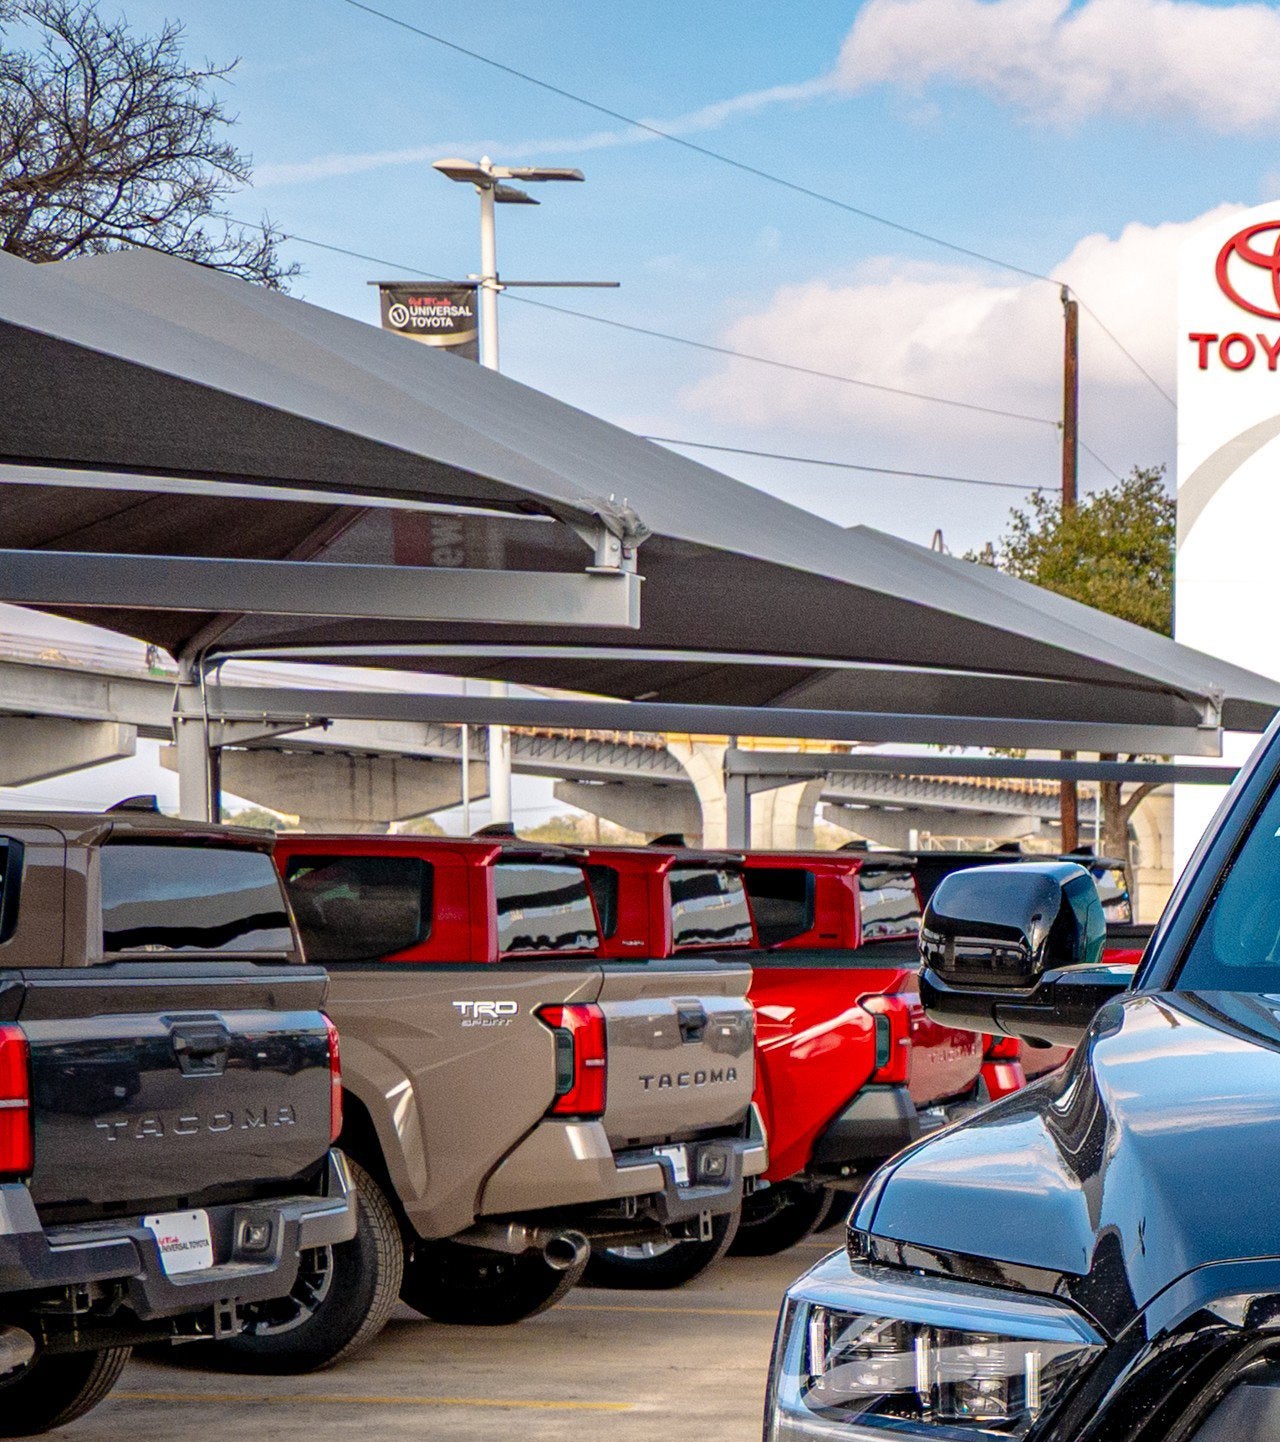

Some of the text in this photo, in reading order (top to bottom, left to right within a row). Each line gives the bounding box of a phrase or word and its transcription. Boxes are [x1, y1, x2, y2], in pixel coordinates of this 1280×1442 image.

[410, 305, 474, 317] UNIVERSAL
[411, 316, 454, 328] TOYOTA
[452, 1000, 519, 1018] TRD
[639, 1067, 738, 1092] TACOMA
[95, 1104, 295, 1141] TACOMA
